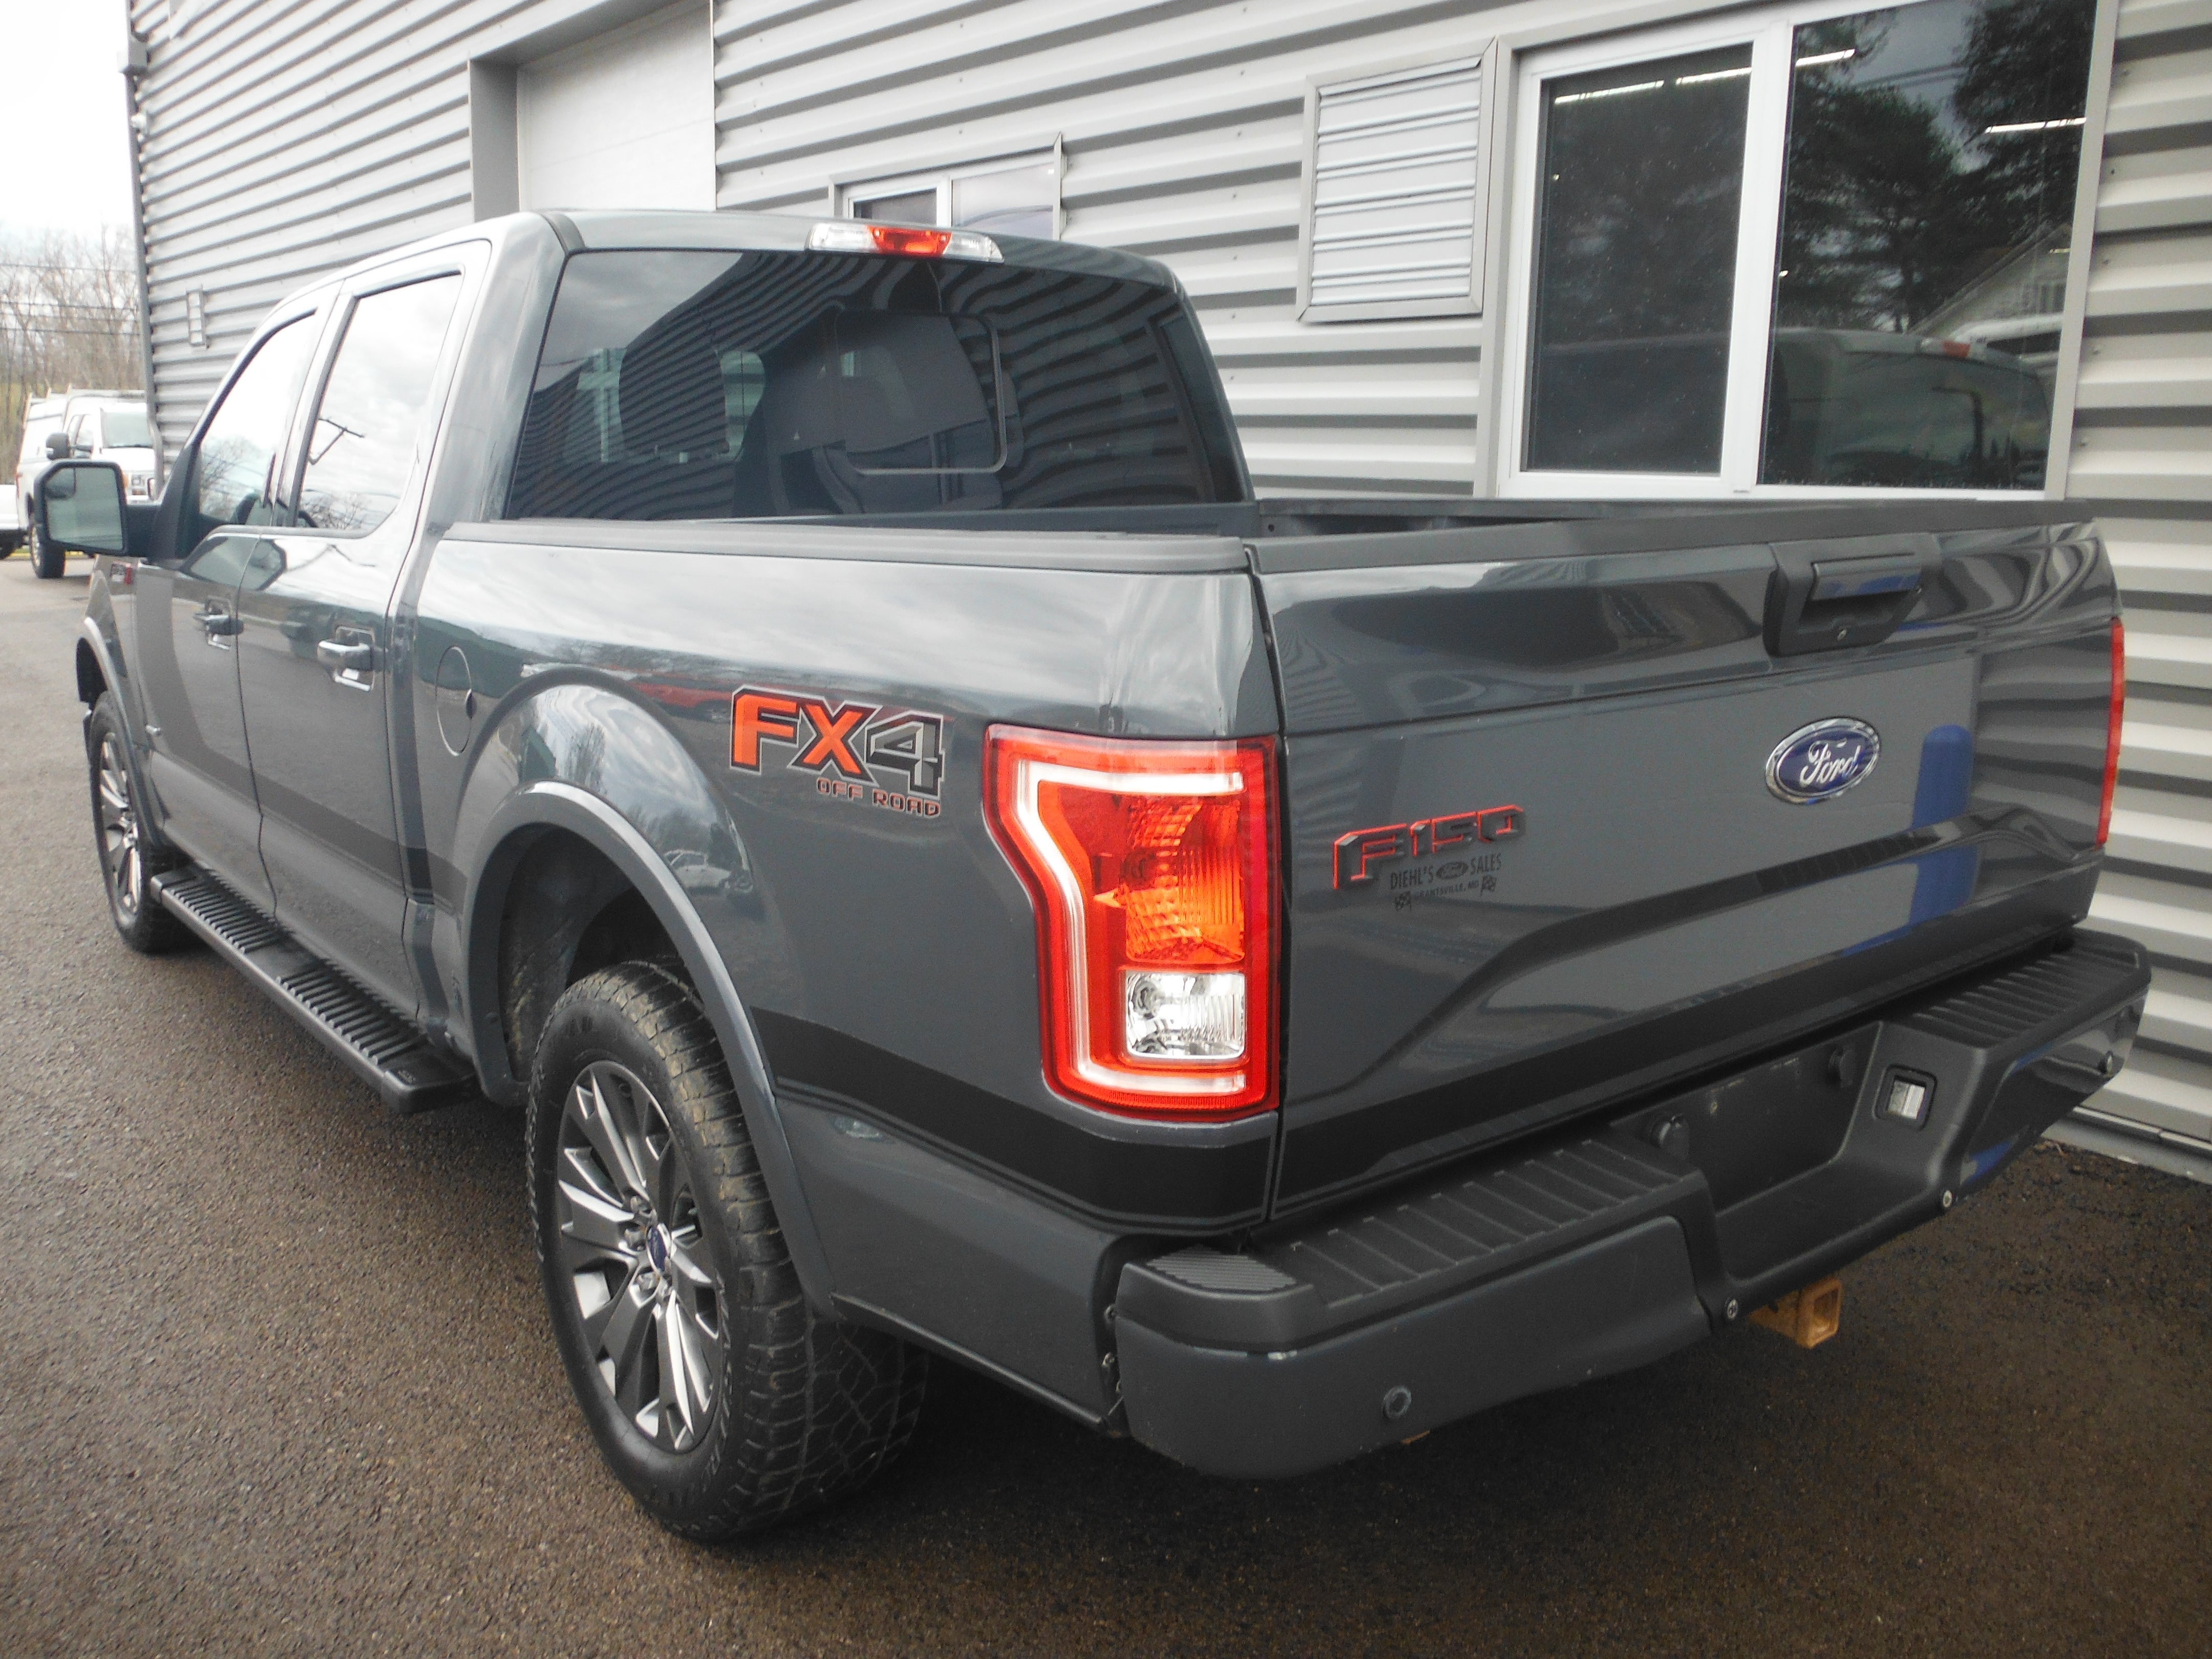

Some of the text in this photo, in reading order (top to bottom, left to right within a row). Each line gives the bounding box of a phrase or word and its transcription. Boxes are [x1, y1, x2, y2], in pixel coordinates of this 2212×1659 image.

[730, 685, 944, 799] FX4
[1800, 738, 1861, 788] Ford
[817, 777, 941, 818] OFF ROAD
[1390, 865, 1434, 890] DIEHL'S
[1470, 853, 1502, 875] SALES
